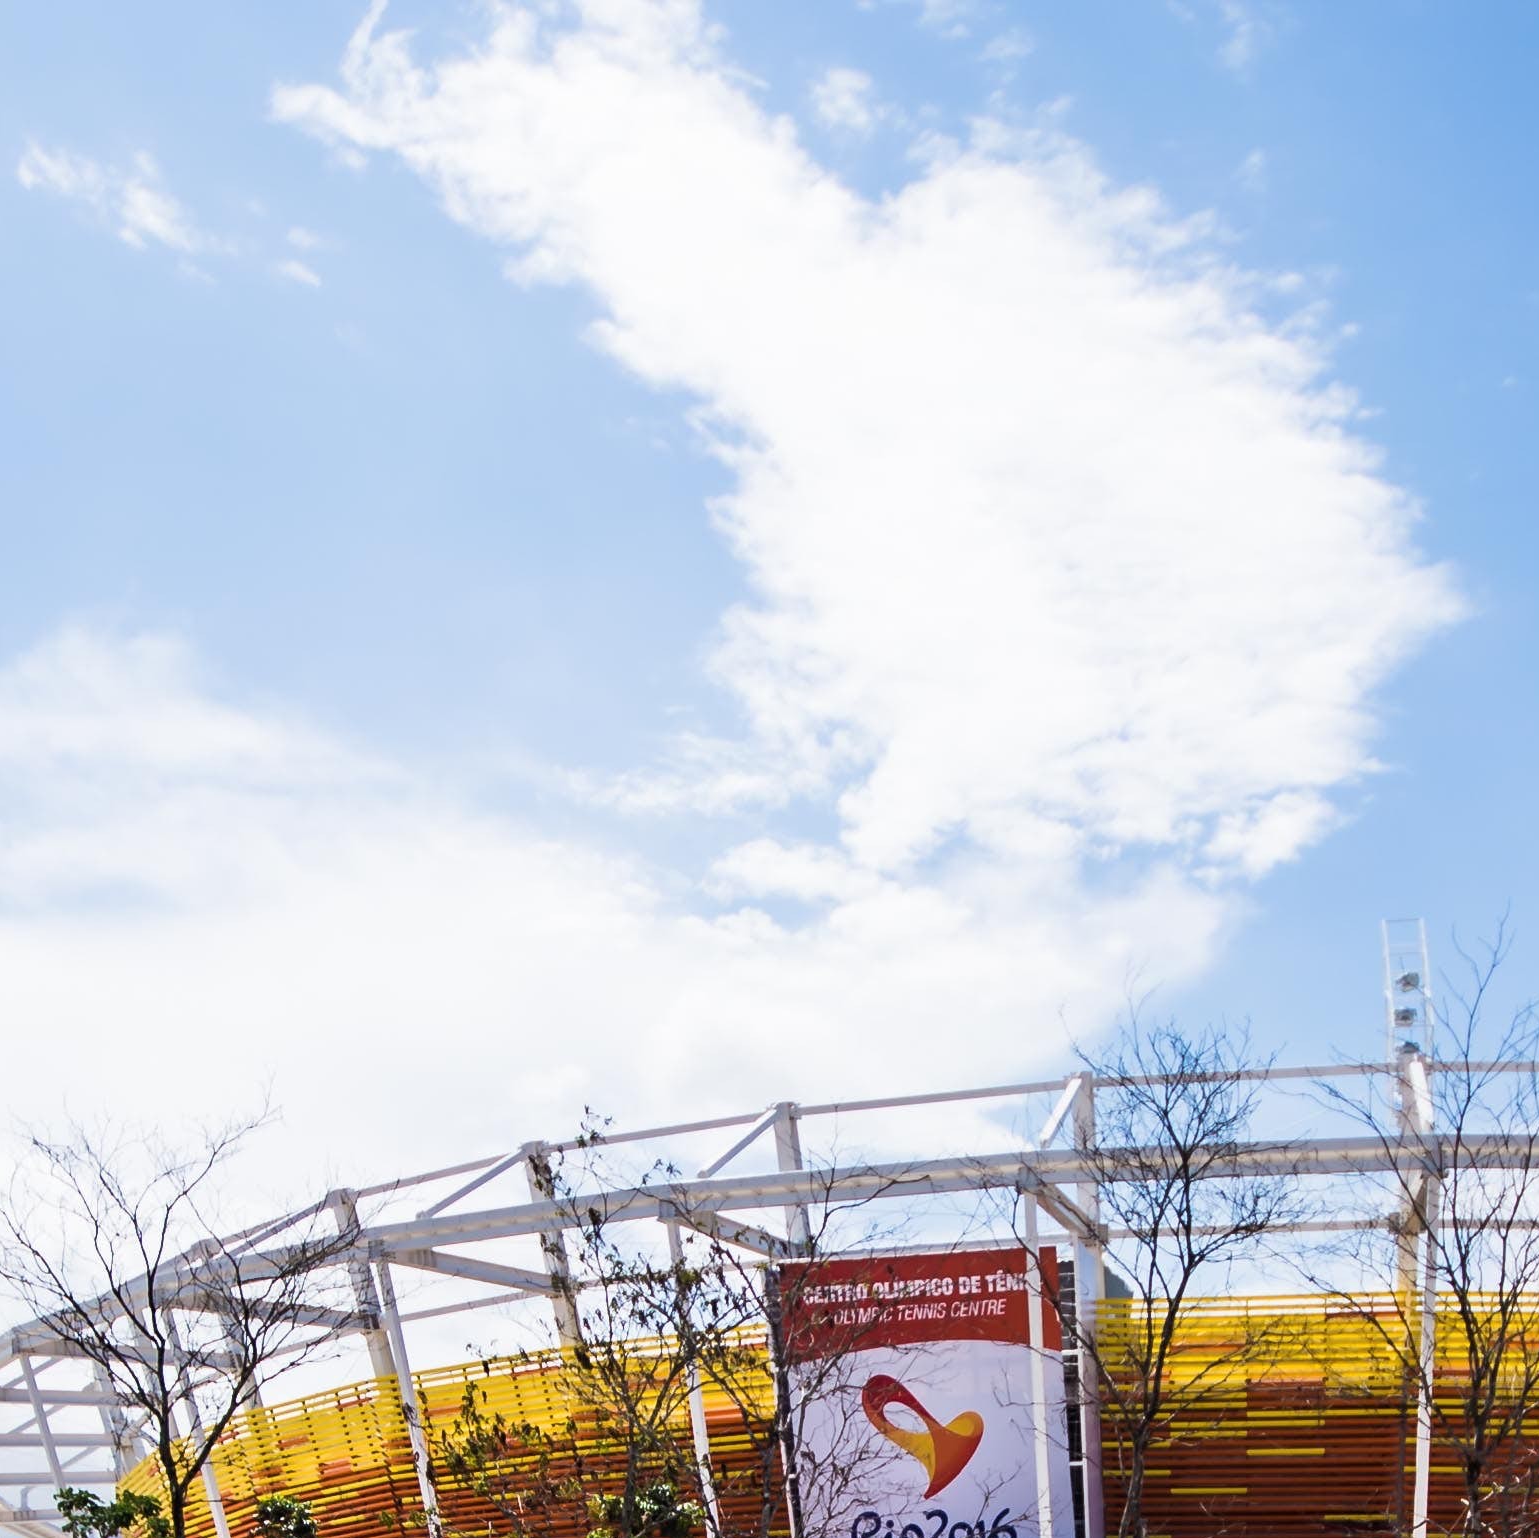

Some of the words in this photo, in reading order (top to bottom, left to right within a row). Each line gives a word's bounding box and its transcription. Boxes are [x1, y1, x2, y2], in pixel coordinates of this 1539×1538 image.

[959, 1275, 982, 1295] DE
[985, 1269, 1043, 1293] TÊNI
[897, 1302, 947, 1321] TENNIS
[950, 1299, 1007, 1317] CENTRE
